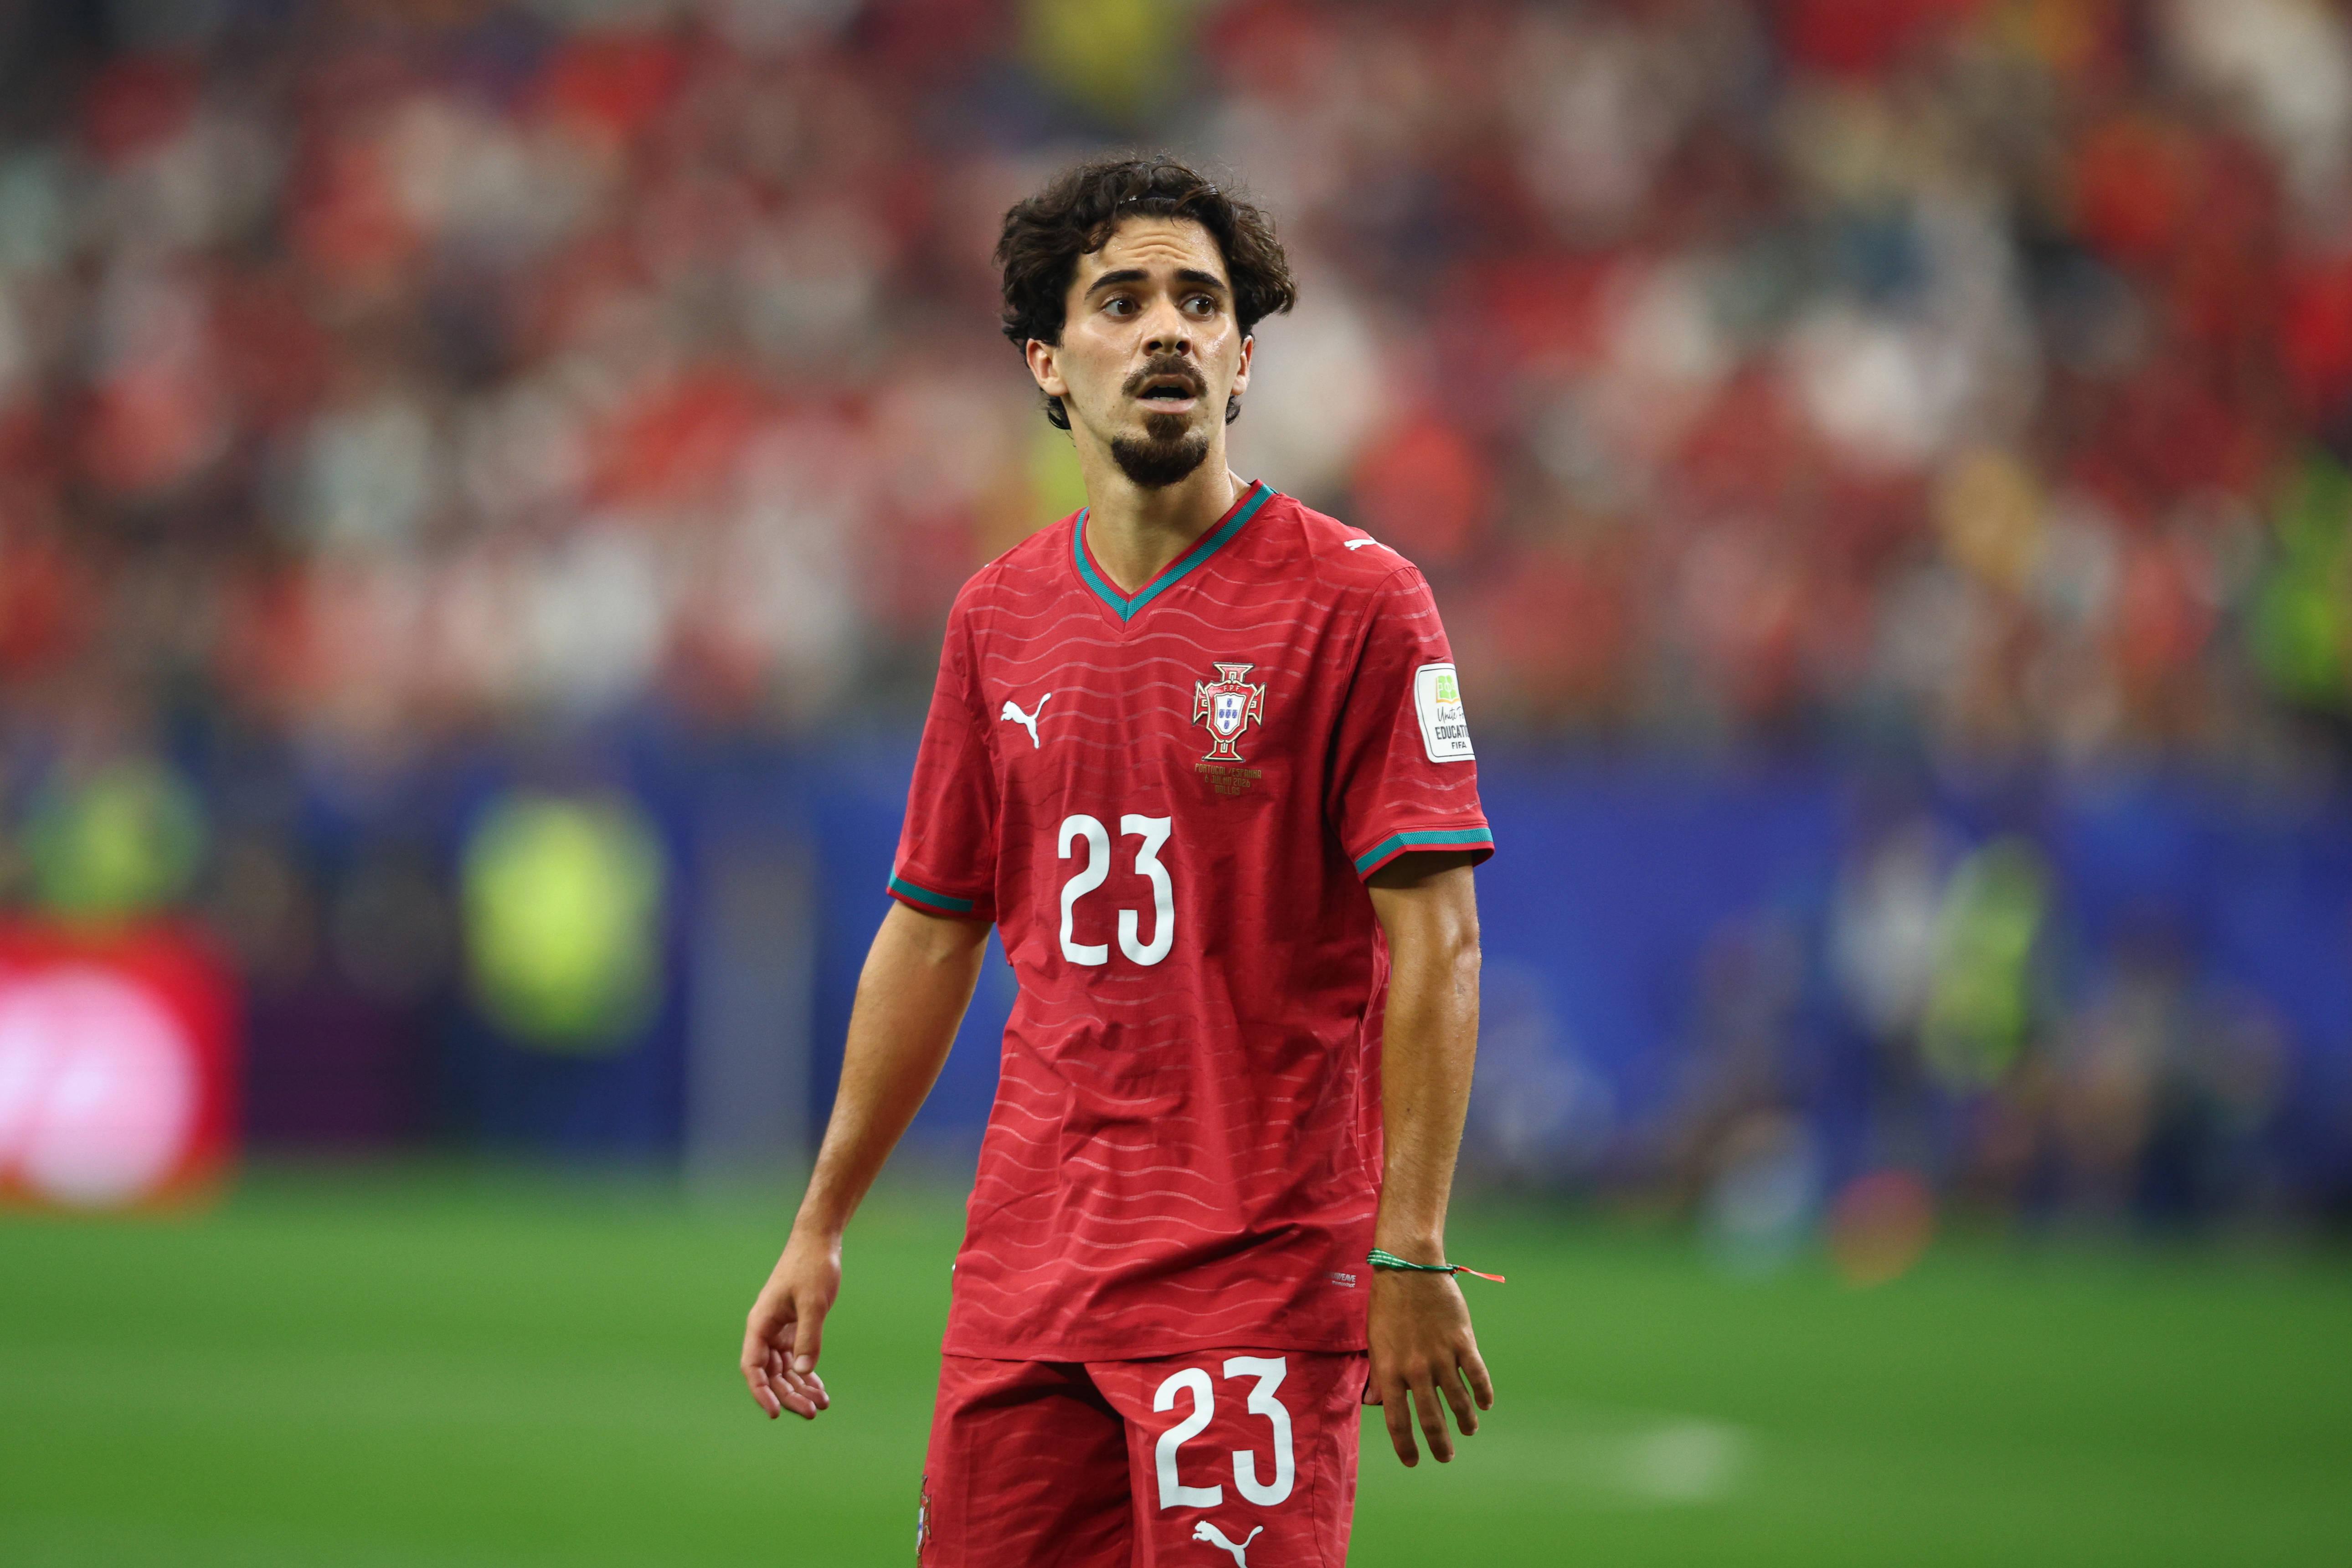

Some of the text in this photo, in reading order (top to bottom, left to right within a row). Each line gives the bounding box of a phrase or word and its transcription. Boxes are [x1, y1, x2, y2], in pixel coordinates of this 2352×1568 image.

[1437, 706, 1457, 724] Unite
[1058, 814, 1174, 966] 23
[1153, 1356, 1295, 1511] 23
